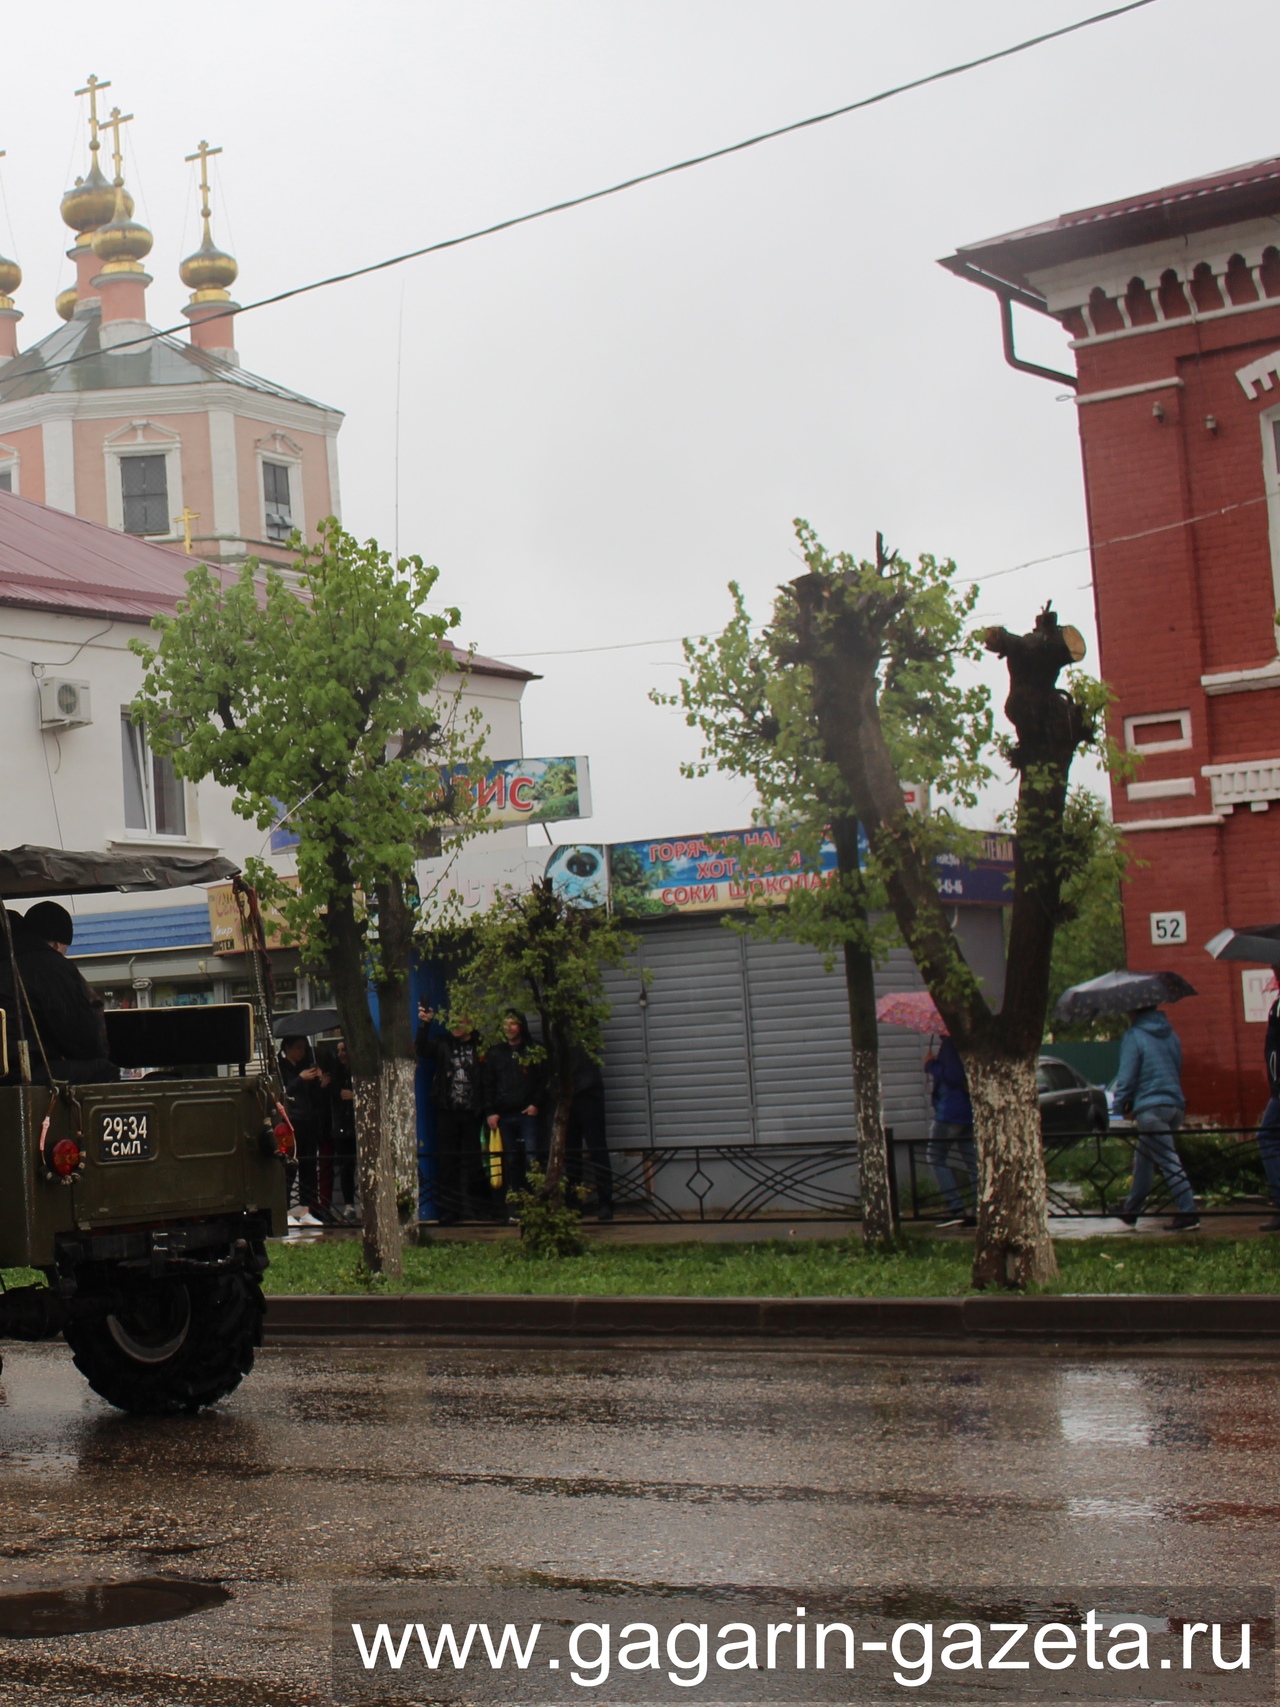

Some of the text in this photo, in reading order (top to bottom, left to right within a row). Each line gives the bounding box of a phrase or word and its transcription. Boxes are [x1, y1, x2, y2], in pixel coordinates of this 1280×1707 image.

[661, 883, 718, 905] СОКИ
[1156, 919, 1181, 938] 52
[111, 1140, 141, 1156] СМЛ
